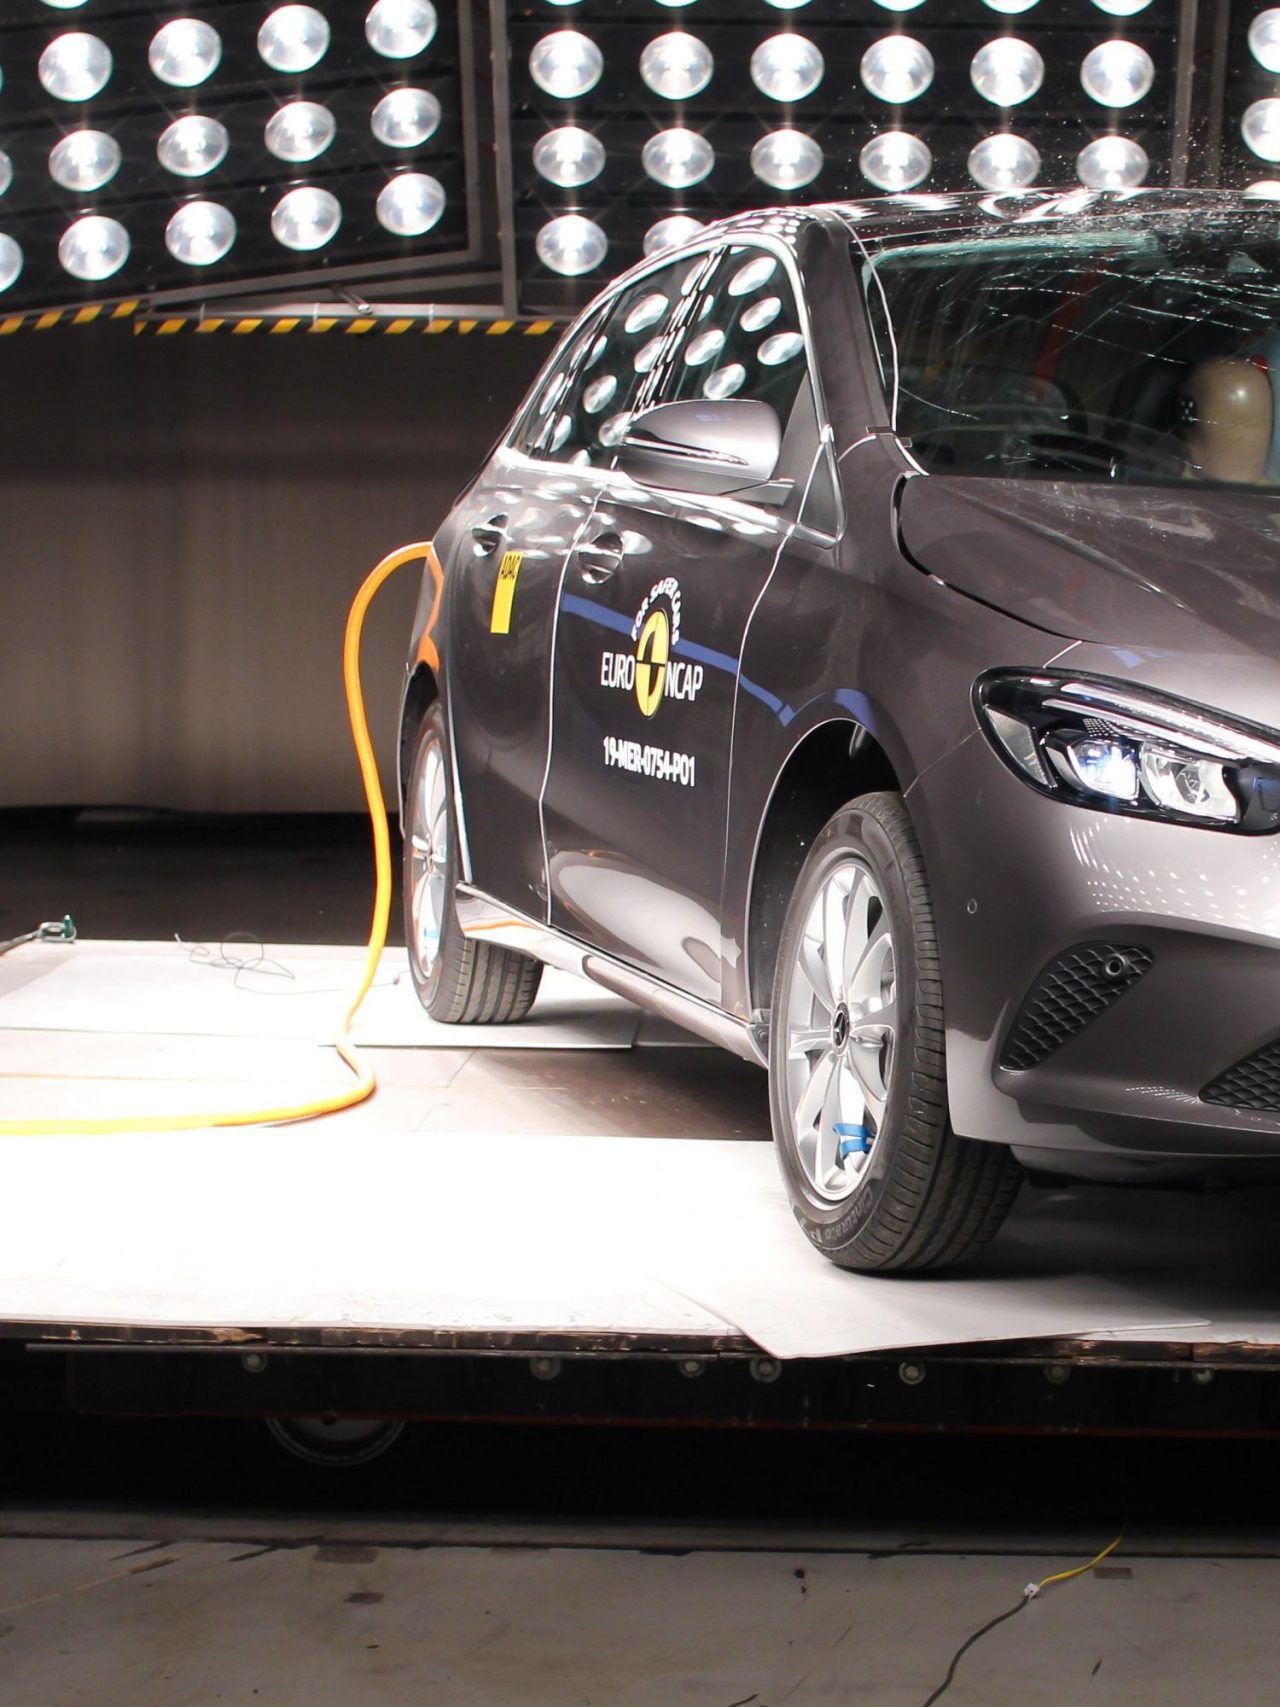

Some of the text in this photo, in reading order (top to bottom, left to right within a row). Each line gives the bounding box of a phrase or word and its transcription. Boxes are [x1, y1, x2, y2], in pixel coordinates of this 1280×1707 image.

[631, 597, 649, 642] FOR
[649, 576, 679, 604] SAFER
[601, 651, 704, 702] EURO NCAP
[603, 736, 695, 787] 19-MER-0754-P01
